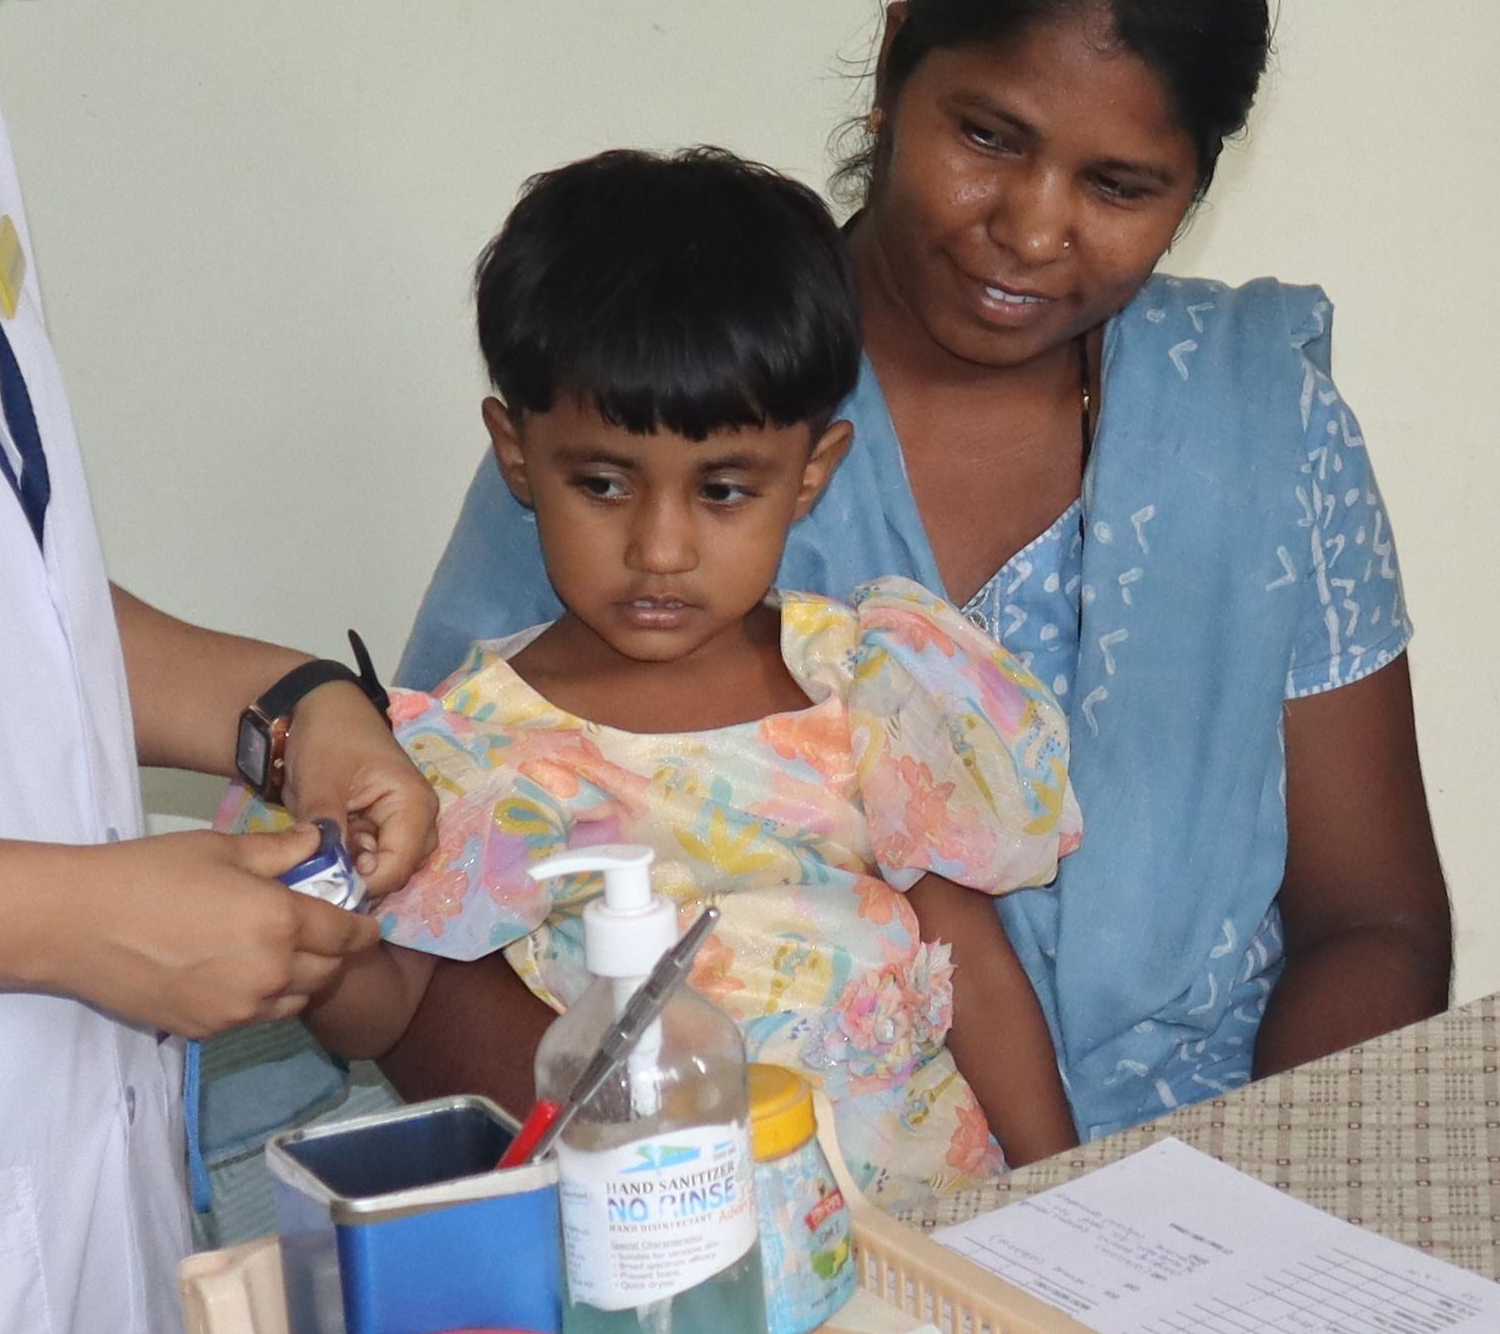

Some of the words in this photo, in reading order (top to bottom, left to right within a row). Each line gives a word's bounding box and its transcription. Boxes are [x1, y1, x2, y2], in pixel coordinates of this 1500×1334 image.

[606, 1183, 653, 1195] HAND
[660, 1161, 734, 1191] SANITIZER
[608, 1197, 648, 1223] NO
[659, 1176, 734, 1218] RINSE
[609, 1225, 638, 1233] HAND
